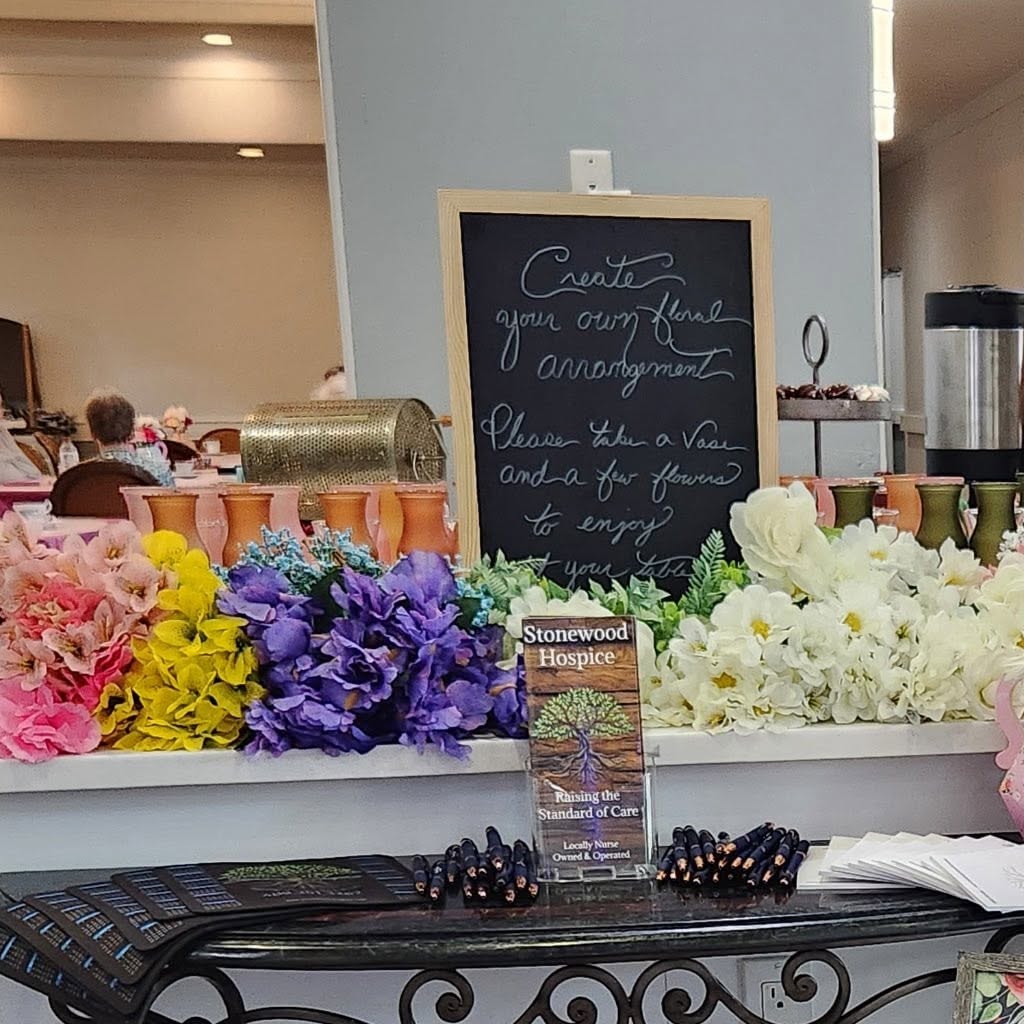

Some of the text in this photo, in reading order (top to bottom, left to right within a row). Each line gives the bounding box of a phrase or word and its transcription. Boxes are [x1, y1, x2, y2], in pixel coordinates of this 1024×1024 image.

[520, 245, 686, 299] Create
[496, 306, 561, 371] your
[537, 345, 736, 399] arrangement
[480, 403, 581, 451] Please
[589, 419, 649, 449] take
[655, 431, 676, 447] a
[500, 458, 743, 503] and a few flowers
[524, 503, 675, 547] to enjoy
[564, 560, 630, 590] your
[635, 550, 699, 579] table
[523, 623, 629, 643] Stonewood
[539, 648, 616, 669] Hospice
[537, 806, 640, 821] Standard of Care
[554, 789, 621, 805] Raising the
[552, 850, 631, 863] Owned & Operated
[562, 840, 619, 852] Locally Nurse
